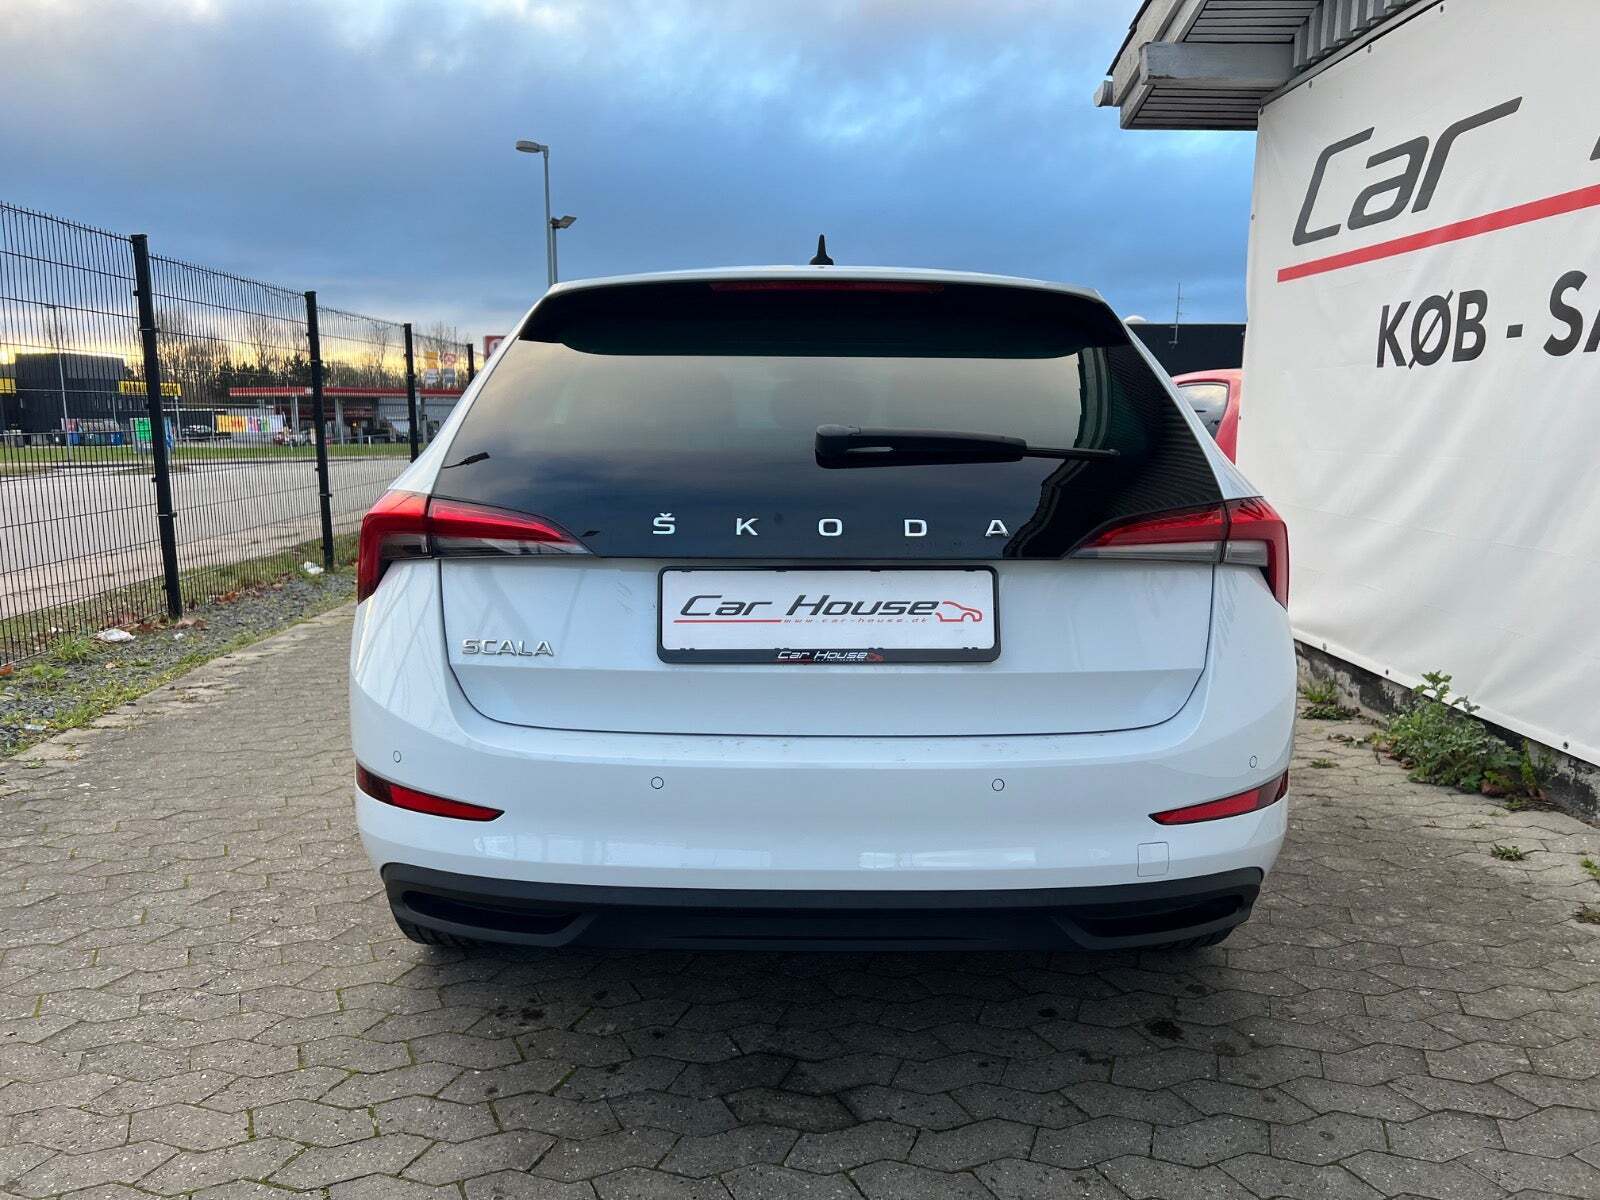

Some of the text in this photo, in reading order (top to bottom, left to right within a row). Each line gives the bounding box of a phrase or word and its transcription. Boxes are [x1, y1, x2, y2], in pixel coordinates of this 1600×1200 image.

[1292, 96, 1522, 246] Car
[1376, 289, 1488, 370] KØB
[1543, 270, 1600, 357] S
[652, 512, 1010, 537] ŠKODA
[680, 594, 940, 616] Car House
[462, 639, 554, 656] SCALA
[777, 650, 868, 660] Car House
